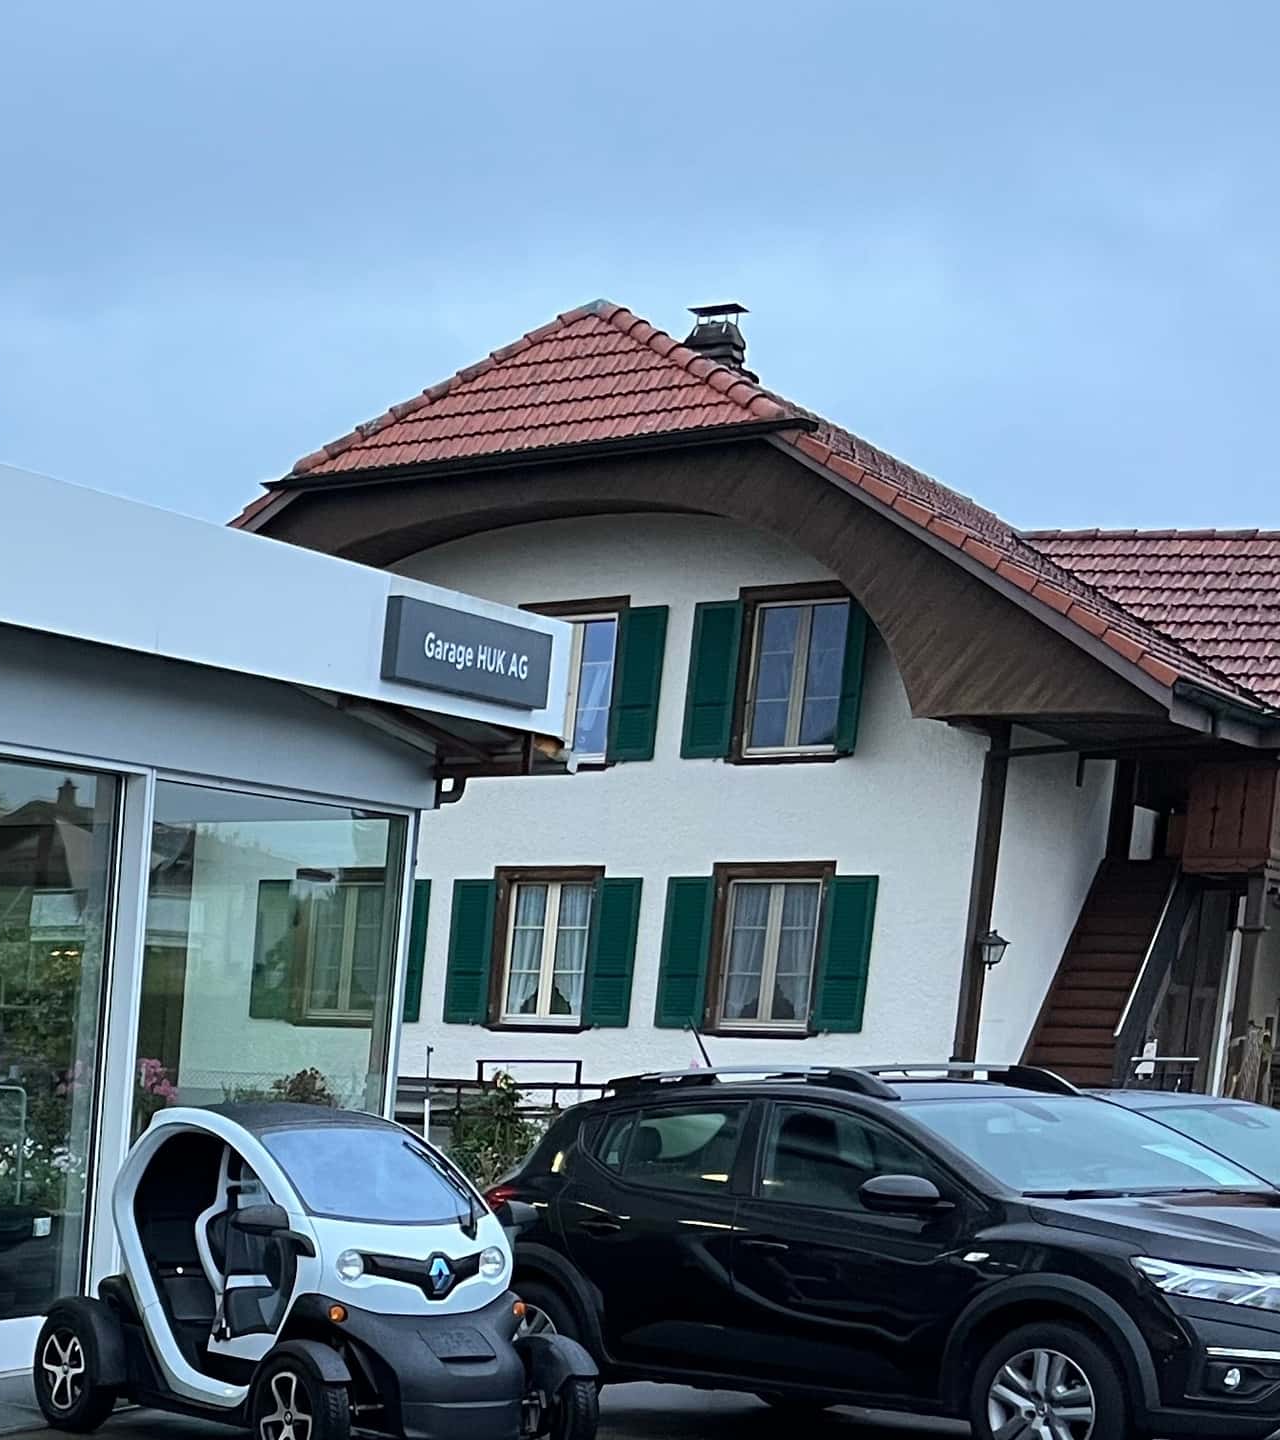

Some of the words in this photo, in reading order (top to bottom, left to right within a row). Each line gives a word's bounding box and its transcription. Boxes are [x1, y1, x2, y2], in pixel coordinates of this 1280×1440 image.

[424, 632, 473, 670] Garage
[477, 645, 505, 675] HUK
[508, 653, 528, 680] AG
